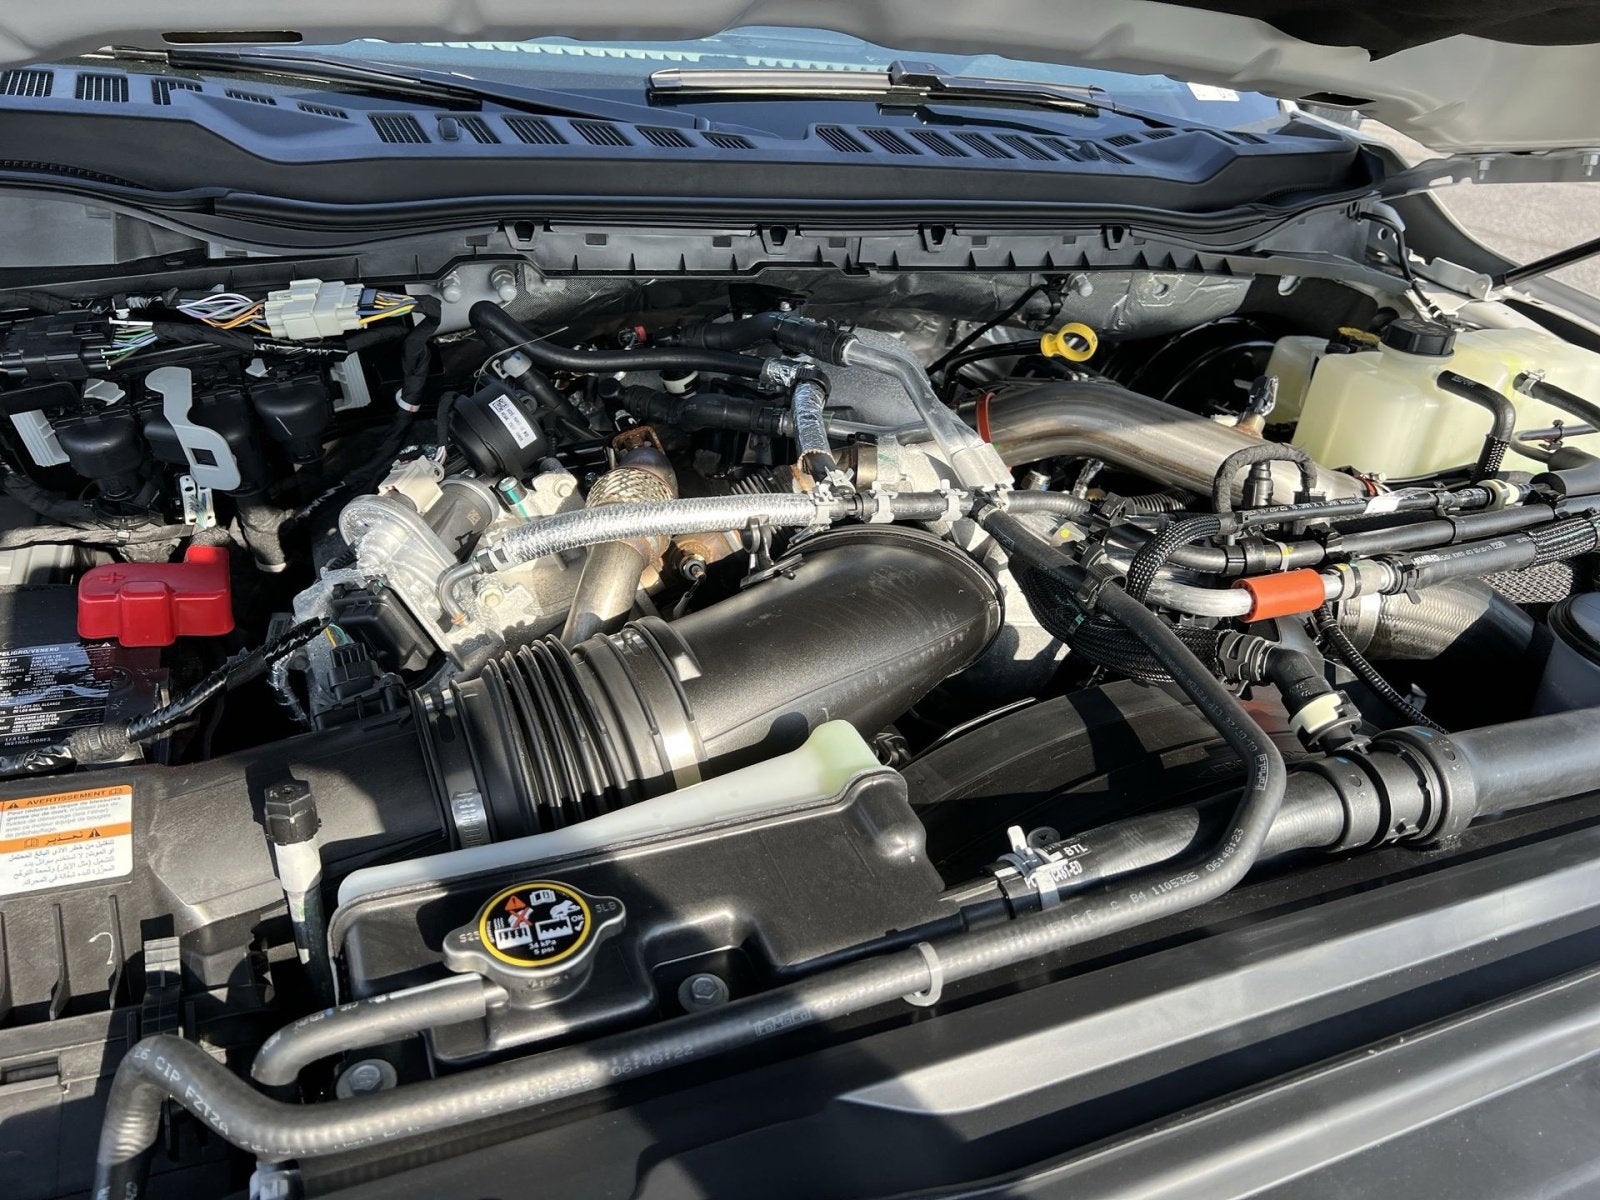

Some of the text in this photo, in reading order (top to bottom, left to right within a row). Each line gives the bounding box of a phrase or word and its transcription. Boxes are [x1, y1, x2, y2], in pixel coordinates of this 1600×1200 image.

[26, 790, 106, 806] AVERTISSEMENT
[1130, 890, 1146, 904] B4
[1151, 871, 1199, 896] 1105325
[1205, 827, 1244, 872] 06:48:23
[571, 914, 585, 922] OK
[541, 939, 557, 948] kPa
[541, 946, 555, 955] psi
[155, 1056, 181, 1082] CIP
